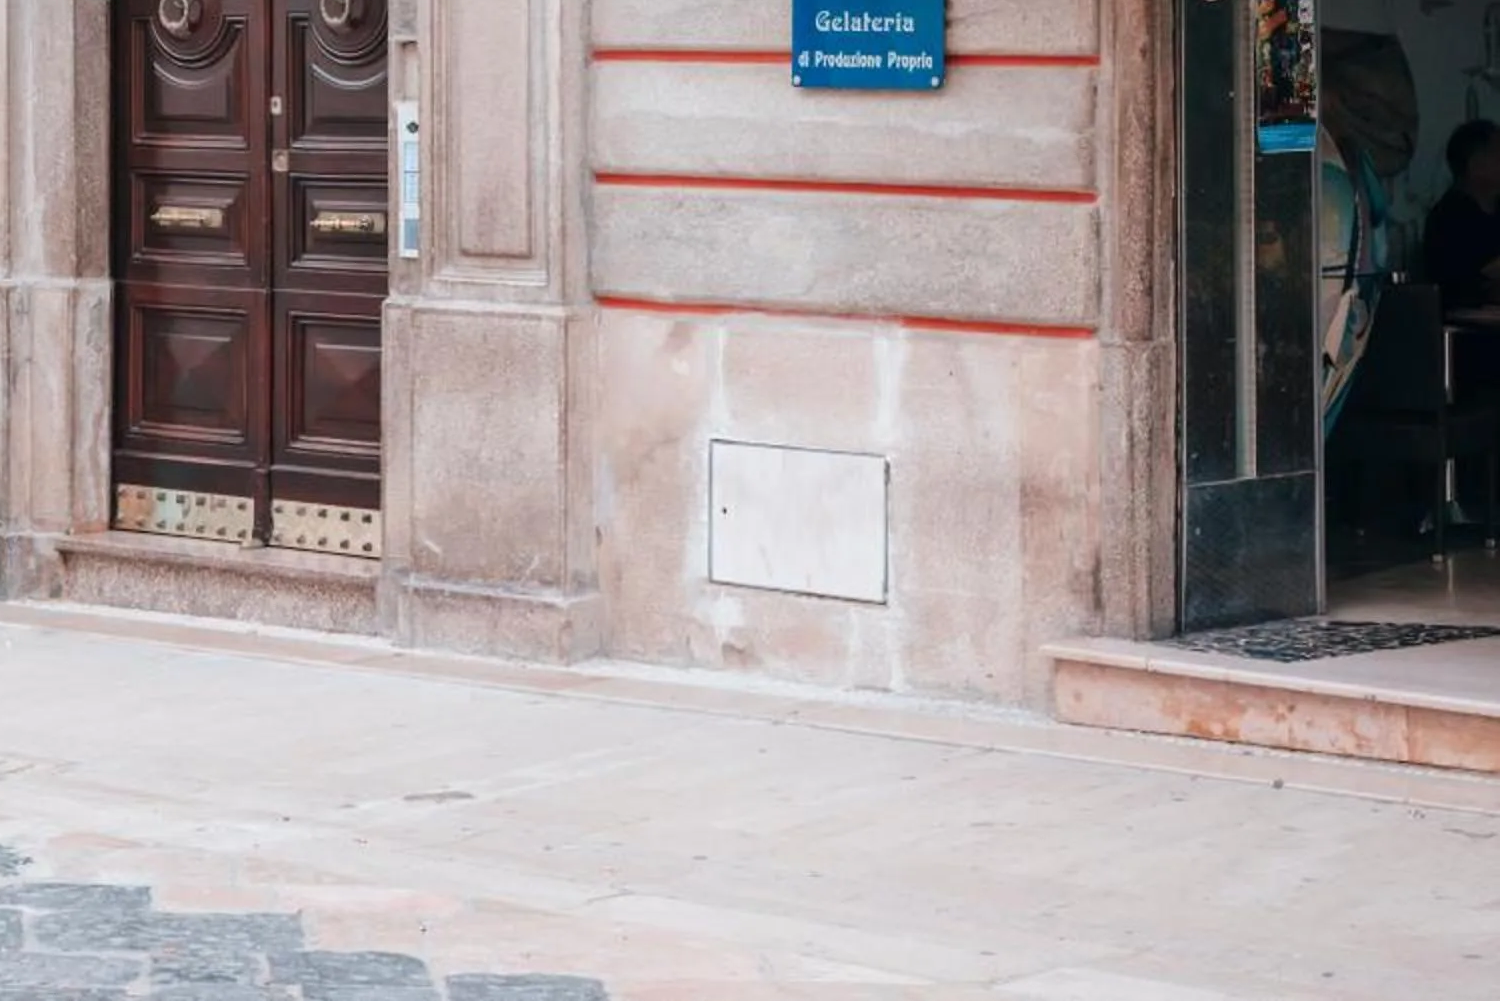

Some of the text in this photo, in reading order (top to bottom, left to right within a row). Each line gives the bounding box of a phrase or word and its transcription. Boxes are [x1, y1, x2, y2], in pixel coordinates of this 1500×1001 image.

[815, 10, 914, 32] Gelateria
[798, 50, 933, 72] di Produzione Propria
